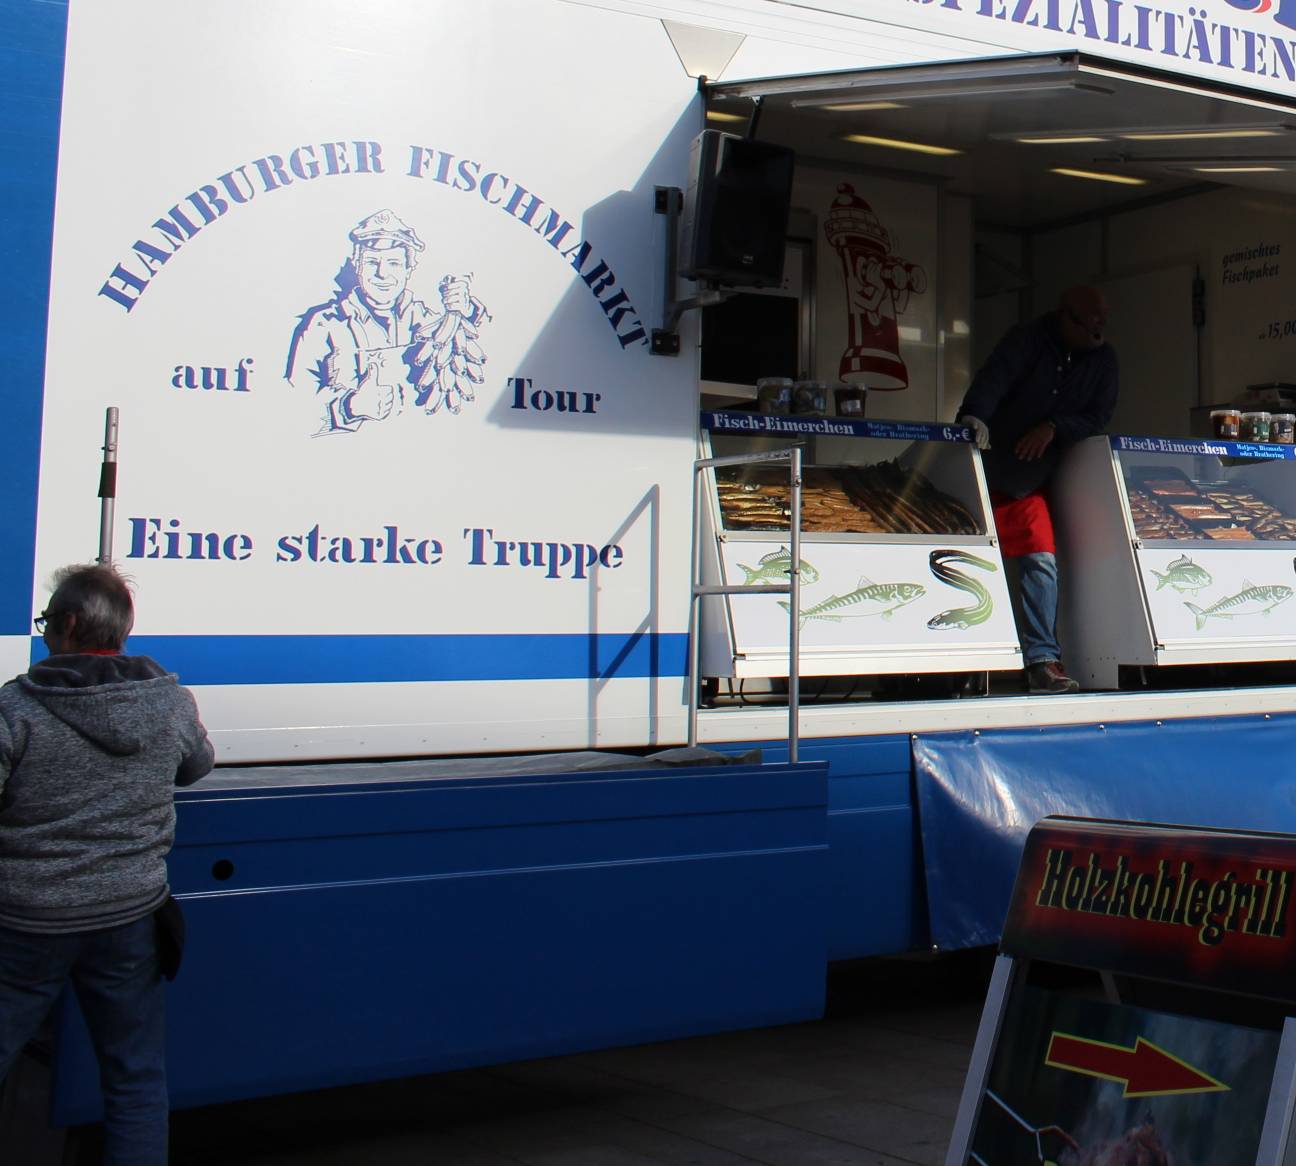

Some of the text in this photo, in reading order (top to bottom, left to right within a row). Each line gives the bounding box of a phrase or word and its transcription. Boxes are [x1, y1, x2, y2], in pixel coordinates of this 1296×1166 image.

[97, 141, 650, 350] HAMBURGER FISCHMARKT
[171, 358, 602, 414] auf Tour
[712, 413, 854, 436] Fisch-Eimerchen
[1119, 436, 1228, 456] Fisch-Eimerchen
[126, 517, 625, 580] Eine starke Truppe
[1035, 848, 1296, 946] Holzkohlegrill
